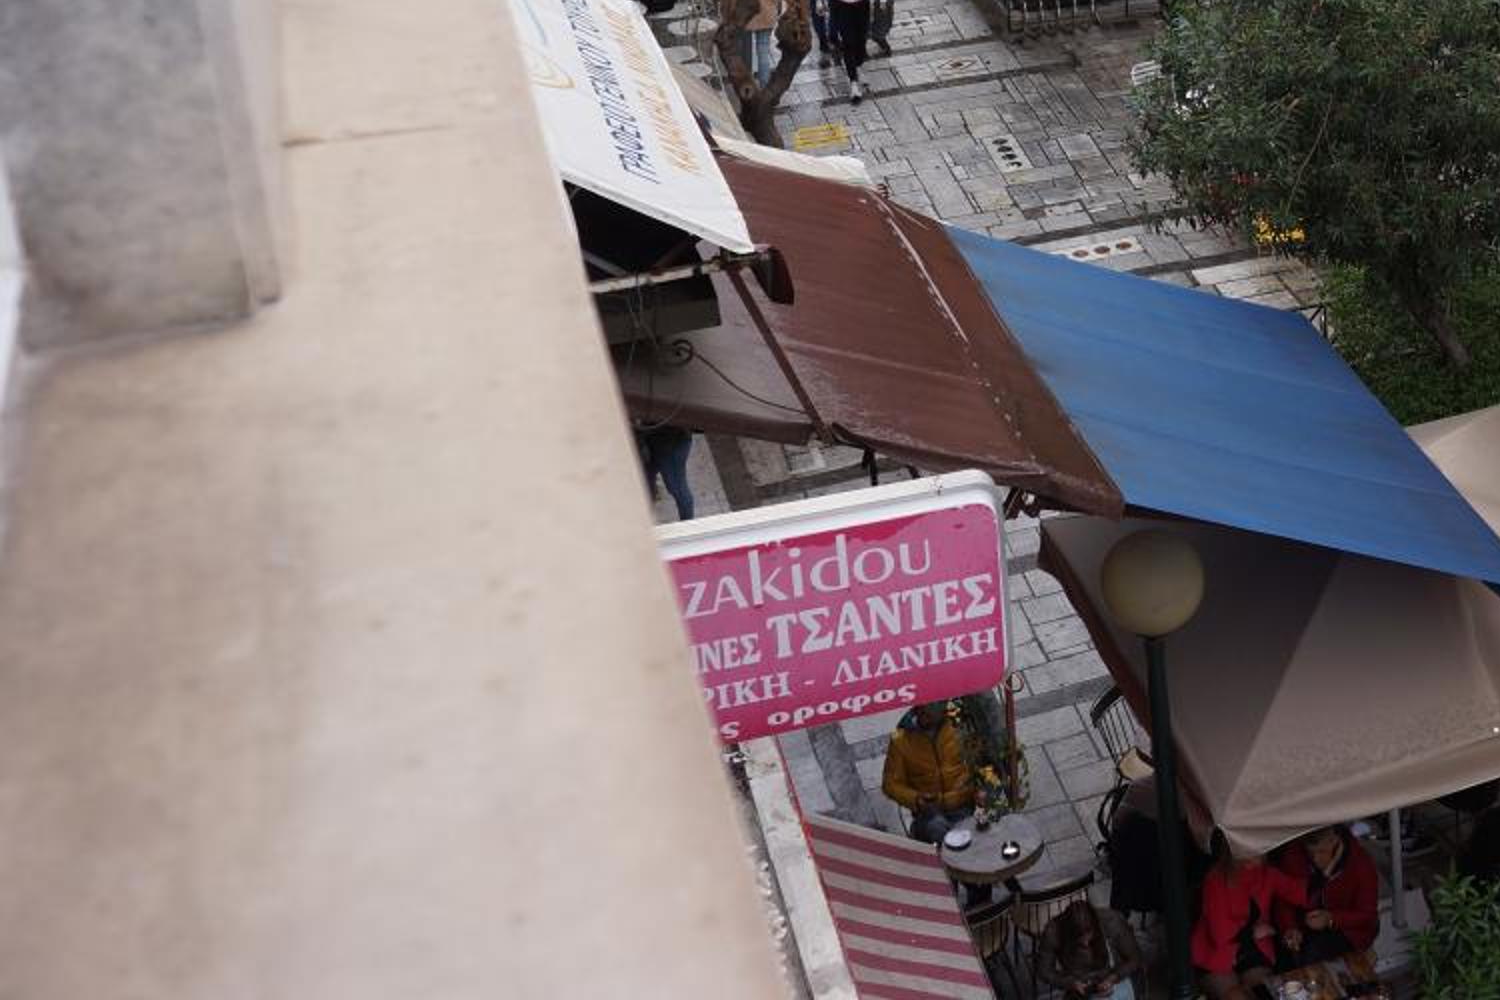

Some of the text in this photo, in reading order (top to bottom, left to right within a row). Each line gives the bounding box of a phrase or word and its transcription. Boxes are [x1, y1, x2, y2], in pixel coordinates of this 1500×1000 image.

[766, 572, 996, 661] ΤΣΑΝΤΕΣ
[831, 627, 998, 687] ΛΙΑΝΙΚΗ
[767, 684, 917, 729] οροφος
